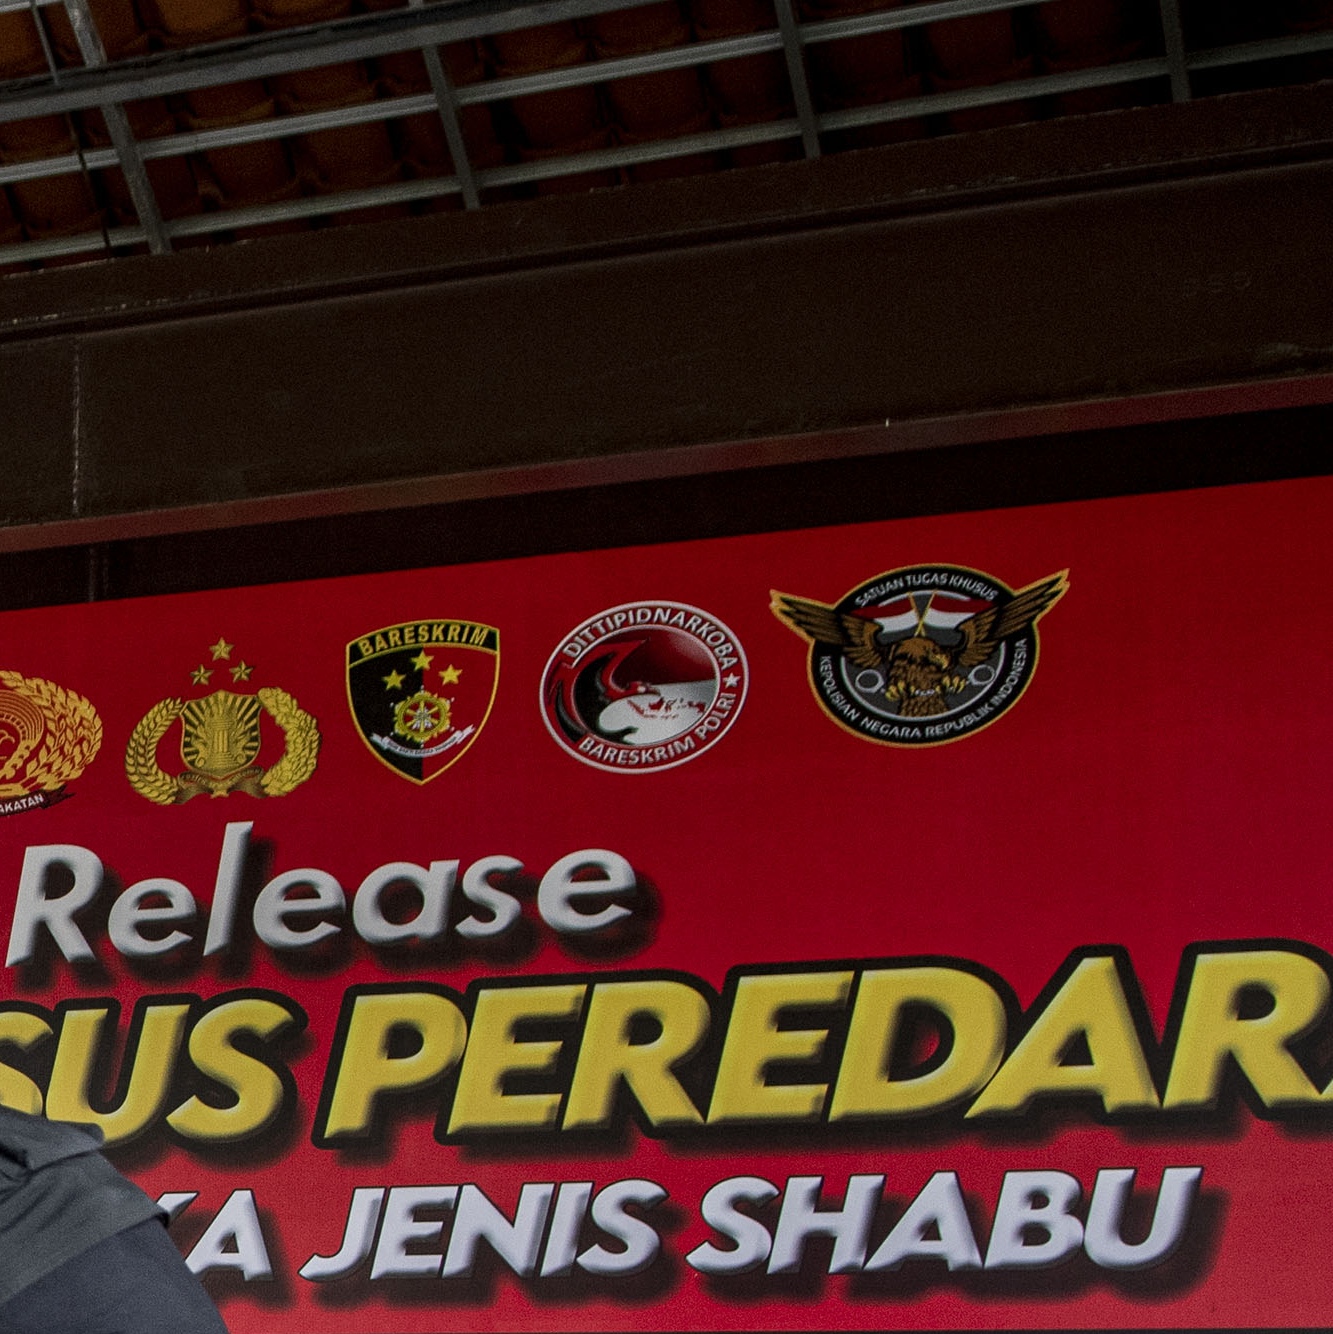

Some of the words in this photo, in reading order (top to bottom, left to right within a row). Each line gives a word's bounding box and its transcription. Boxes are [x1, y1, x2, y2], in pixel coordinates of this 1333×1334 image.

[855, 575, 904, 607] SATUAN
[906, 572, 947, 586] TUGAS
[949, 574, 999, 601] KHUSUS
[358, 623, 490, 656] BARESKRIM
[562, 607, 738, 671] DITTIPIDNARKOBA
[578, 736, 696, 766] BARESKRIM
[695, 692, 737, 741] POLRI
[819, 655, 860, 721] KEPOLISIAN
[860, 716, 921, 738] NEGARA
[925, 702, 995, 738] REPUBLIK
[992, 638, 1028, 707] INDONESIA
[5, 820, 637, 968] Release
[325, 950, 1333, 1139] PEREDAR
[299, 1179, 669, 1281] JENIS
[686, 1167, 1203, 1275] SHABU
